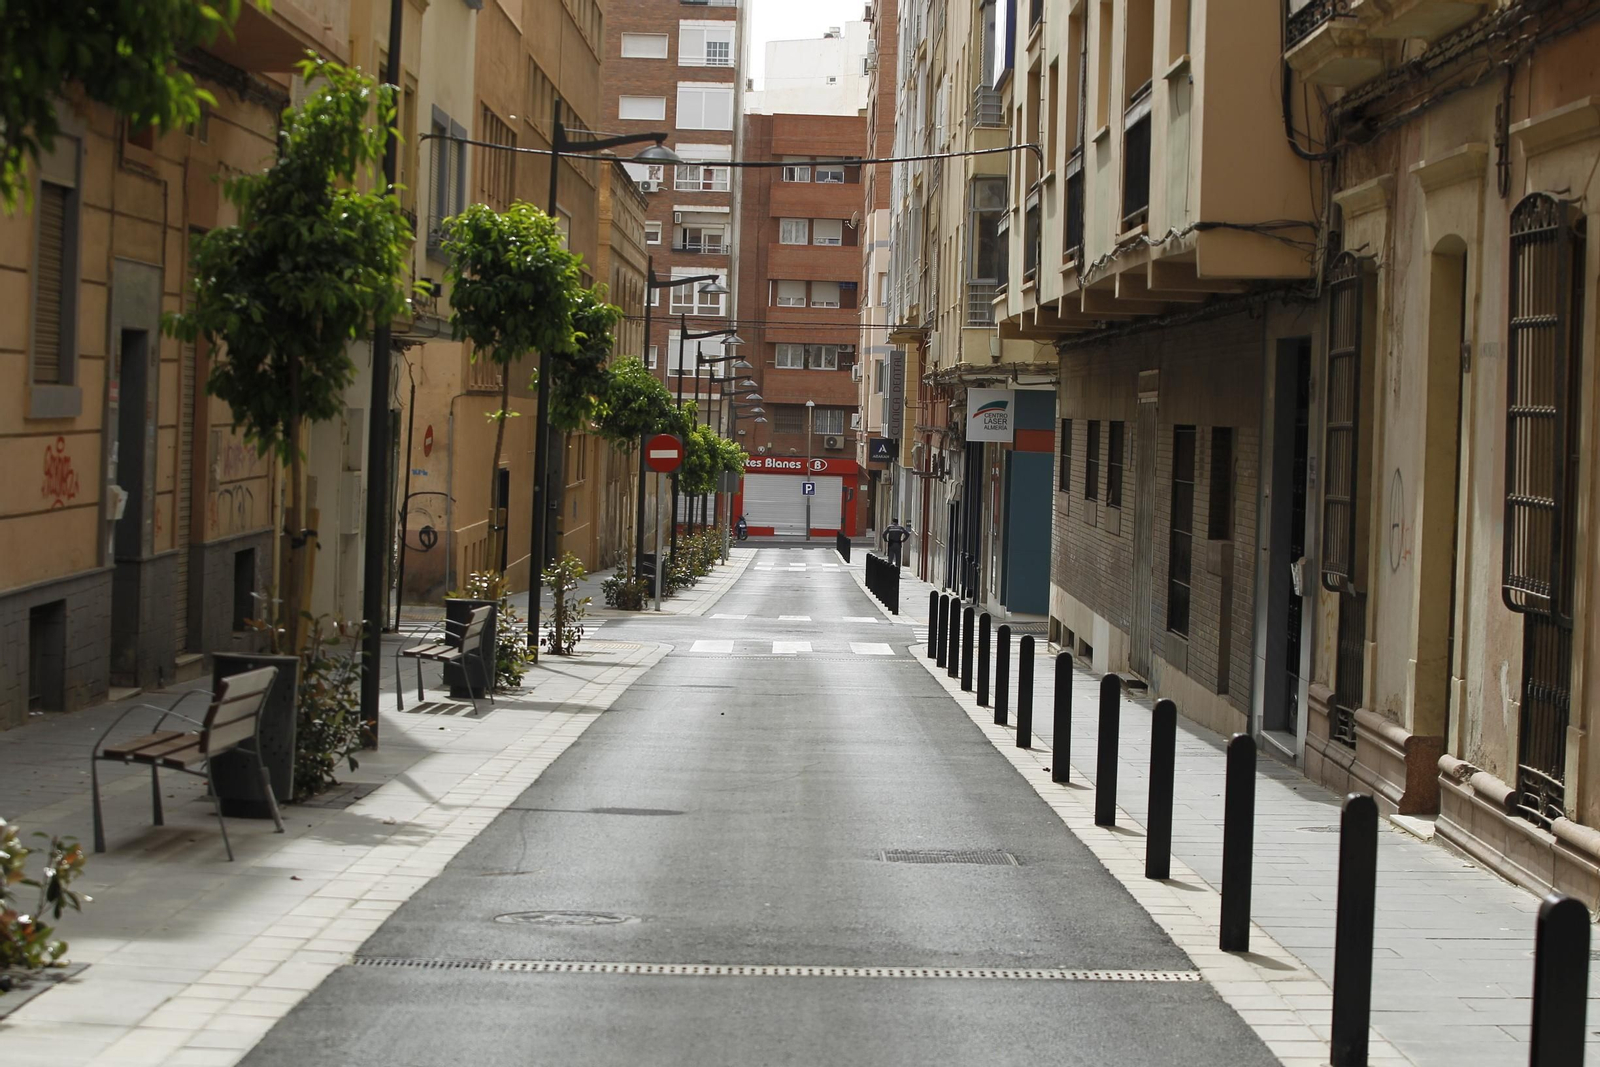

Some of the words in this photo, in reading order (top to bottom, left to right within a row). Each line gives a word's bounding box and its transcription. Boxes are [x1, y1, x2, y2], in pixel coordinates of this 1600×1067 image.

[893, 355, 902, 392] DENTAL
[765, 458, 802, 469] Blanes
[806, 484, 812, 494] P
